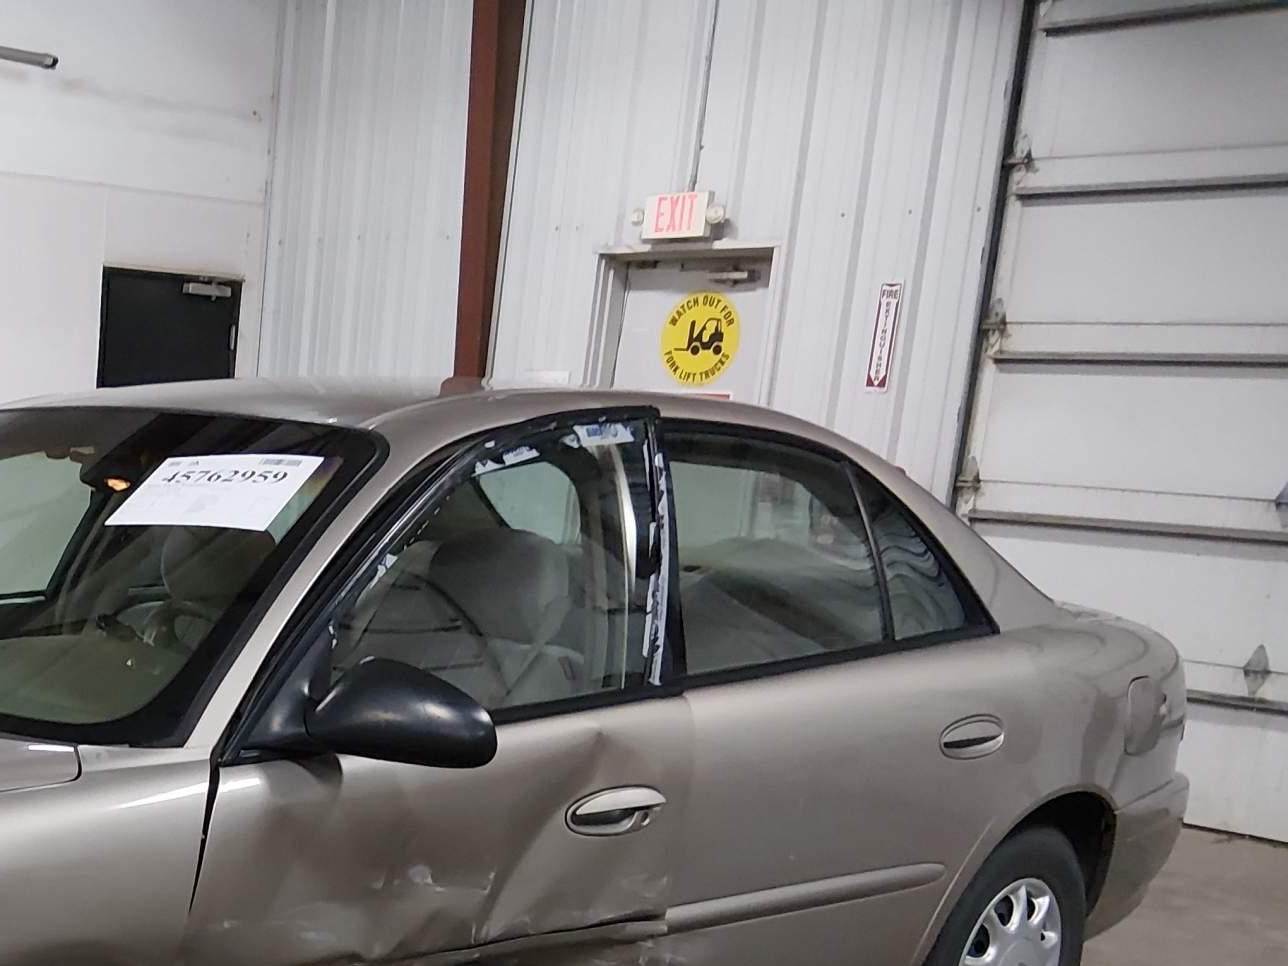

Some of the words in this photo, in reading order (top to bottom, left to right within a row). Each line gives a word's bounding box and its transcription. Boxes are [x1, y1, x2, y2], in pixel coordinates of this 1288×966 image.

[653, 194, 698, 234] EXIT
[668, 295, 700, 327] WATCH
[702, 294, 722, 312] OUT
[719, 300, 735, 327] FOR
[881, 289, 899, 300] FIRE
[664, 350, 680, 375] FORK
[678, 368, 697, 383] LIFT
[699, 352, 731, 382] TRUCKS
[161, 470, 288, 484] 45762959
